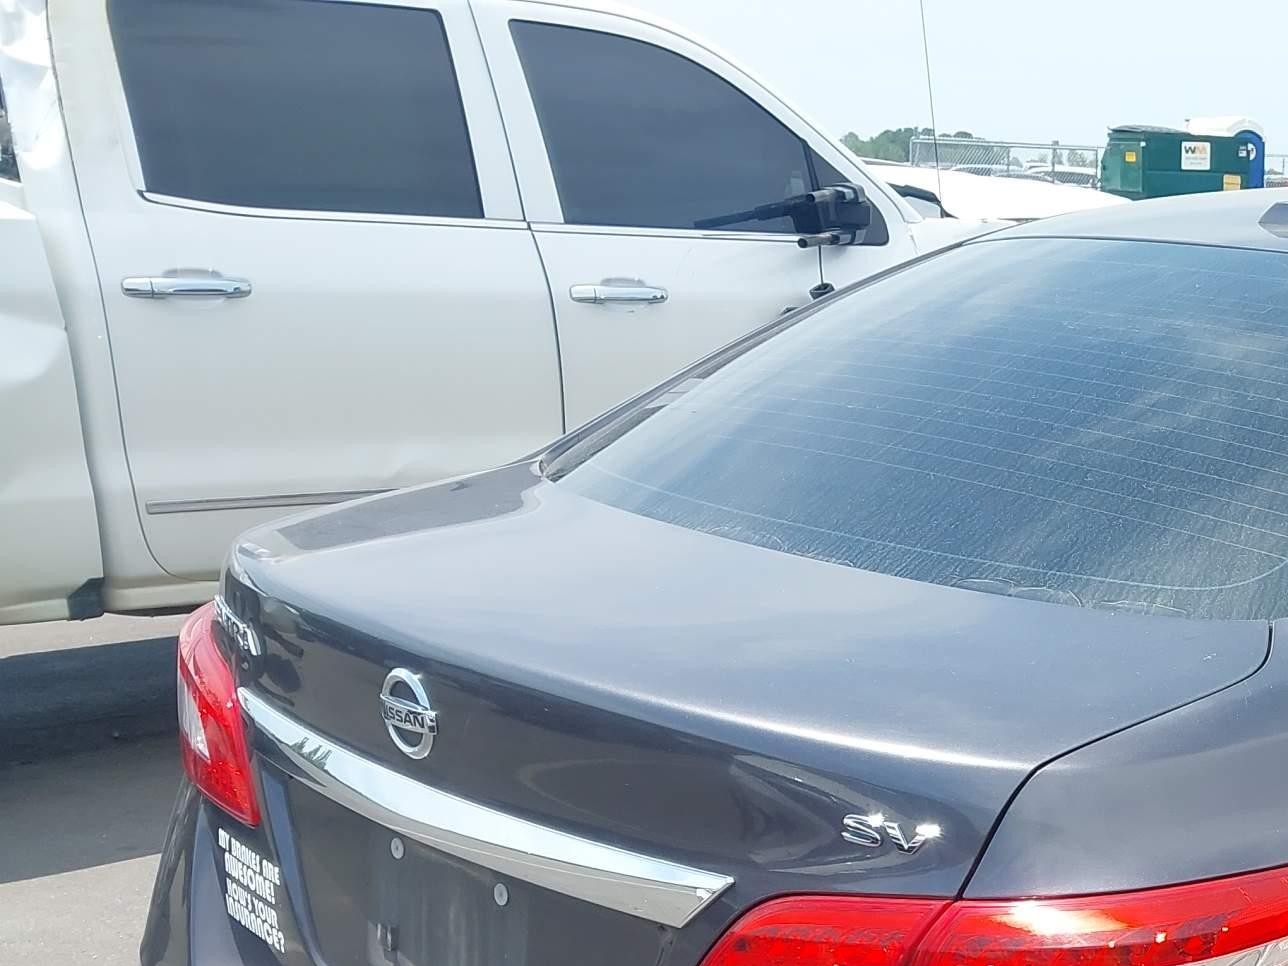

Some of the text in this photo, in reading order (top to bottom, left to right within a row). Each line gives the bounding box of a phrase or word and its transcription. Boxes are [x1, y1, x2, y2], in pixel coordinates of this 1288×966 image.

[218, 827, 280, 886] MY BRAKES ARE
[841, 812, 942, 854] SV
[224, 851, 276, 905] AWESOME!
[226, 877, 279, 929] HOW'S YOUR
[225, 893, 285, 953] INSURANCE?
